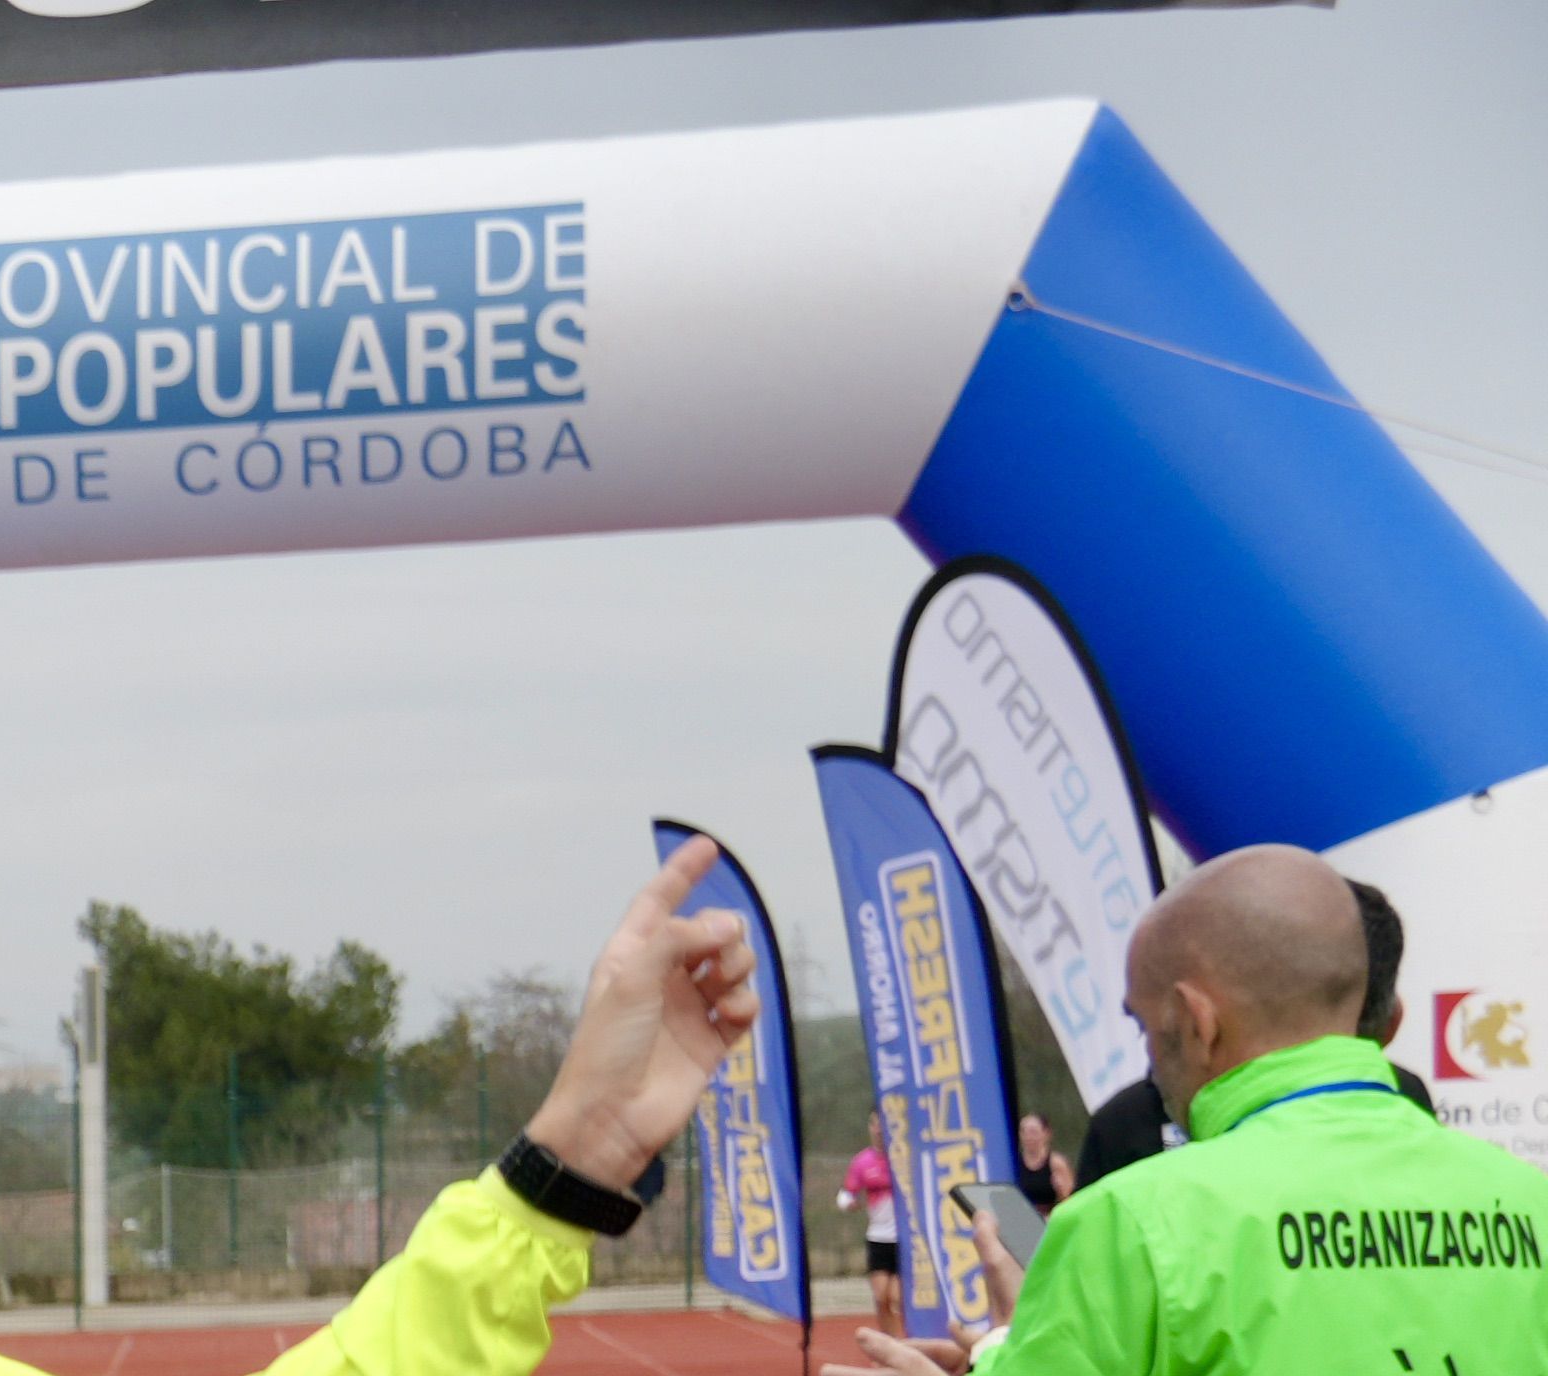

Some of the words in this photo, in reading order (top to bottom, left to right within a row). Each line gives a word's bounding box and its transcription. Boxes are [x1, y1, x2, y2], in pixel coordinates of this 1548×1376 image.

[473, 212, 585, 298] DE
[12, 448, 110, 506] DE
[175, 419, 592, 497] CÓRDOBA
[1481, 1098, 1522, 1126] de
[1277, 1199, 1542, 1270] ORGANIZACIÓN
